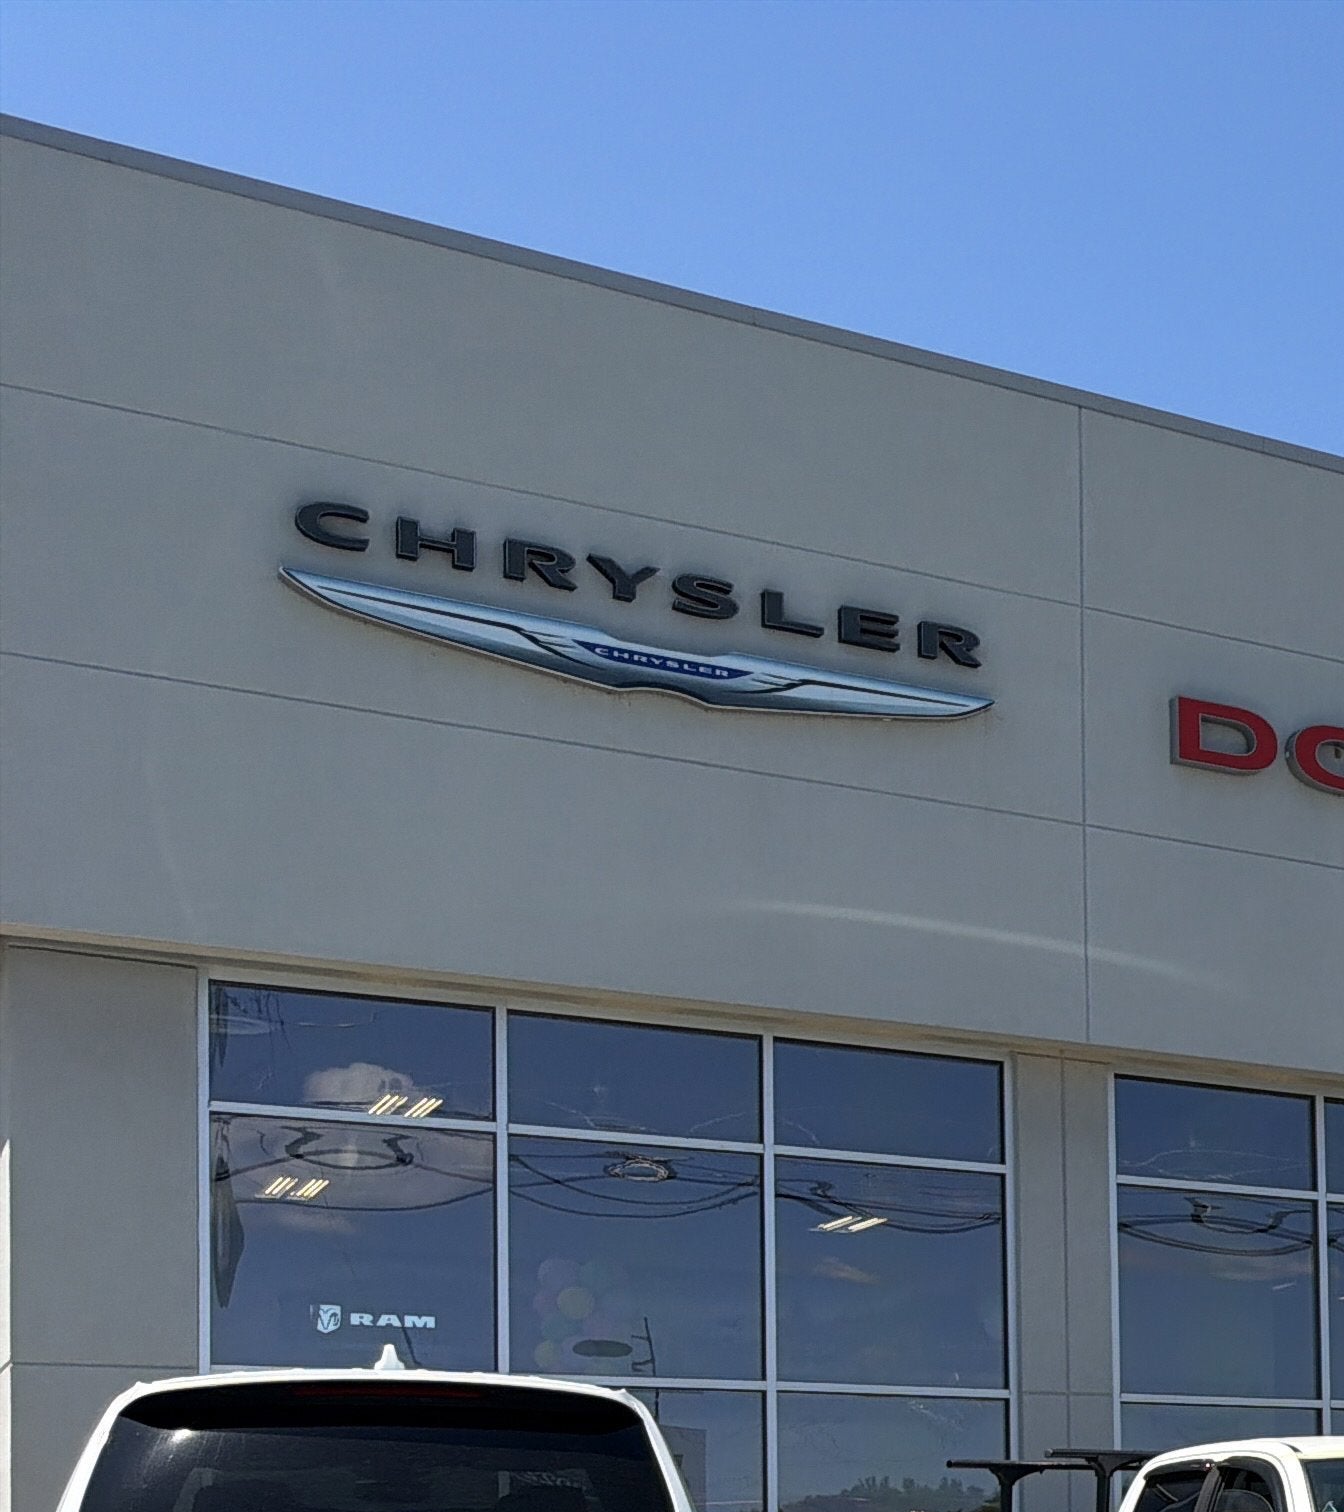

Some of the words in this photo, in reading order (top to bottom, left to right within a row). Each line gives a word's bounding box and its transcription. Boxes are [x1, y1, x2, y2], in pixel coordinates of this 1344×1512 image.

[294, 500, 983, 669] CHRYSLER
[594, 647, 729, 678] CHRYSLER
[350, 1312, 436, 1329] RAM
